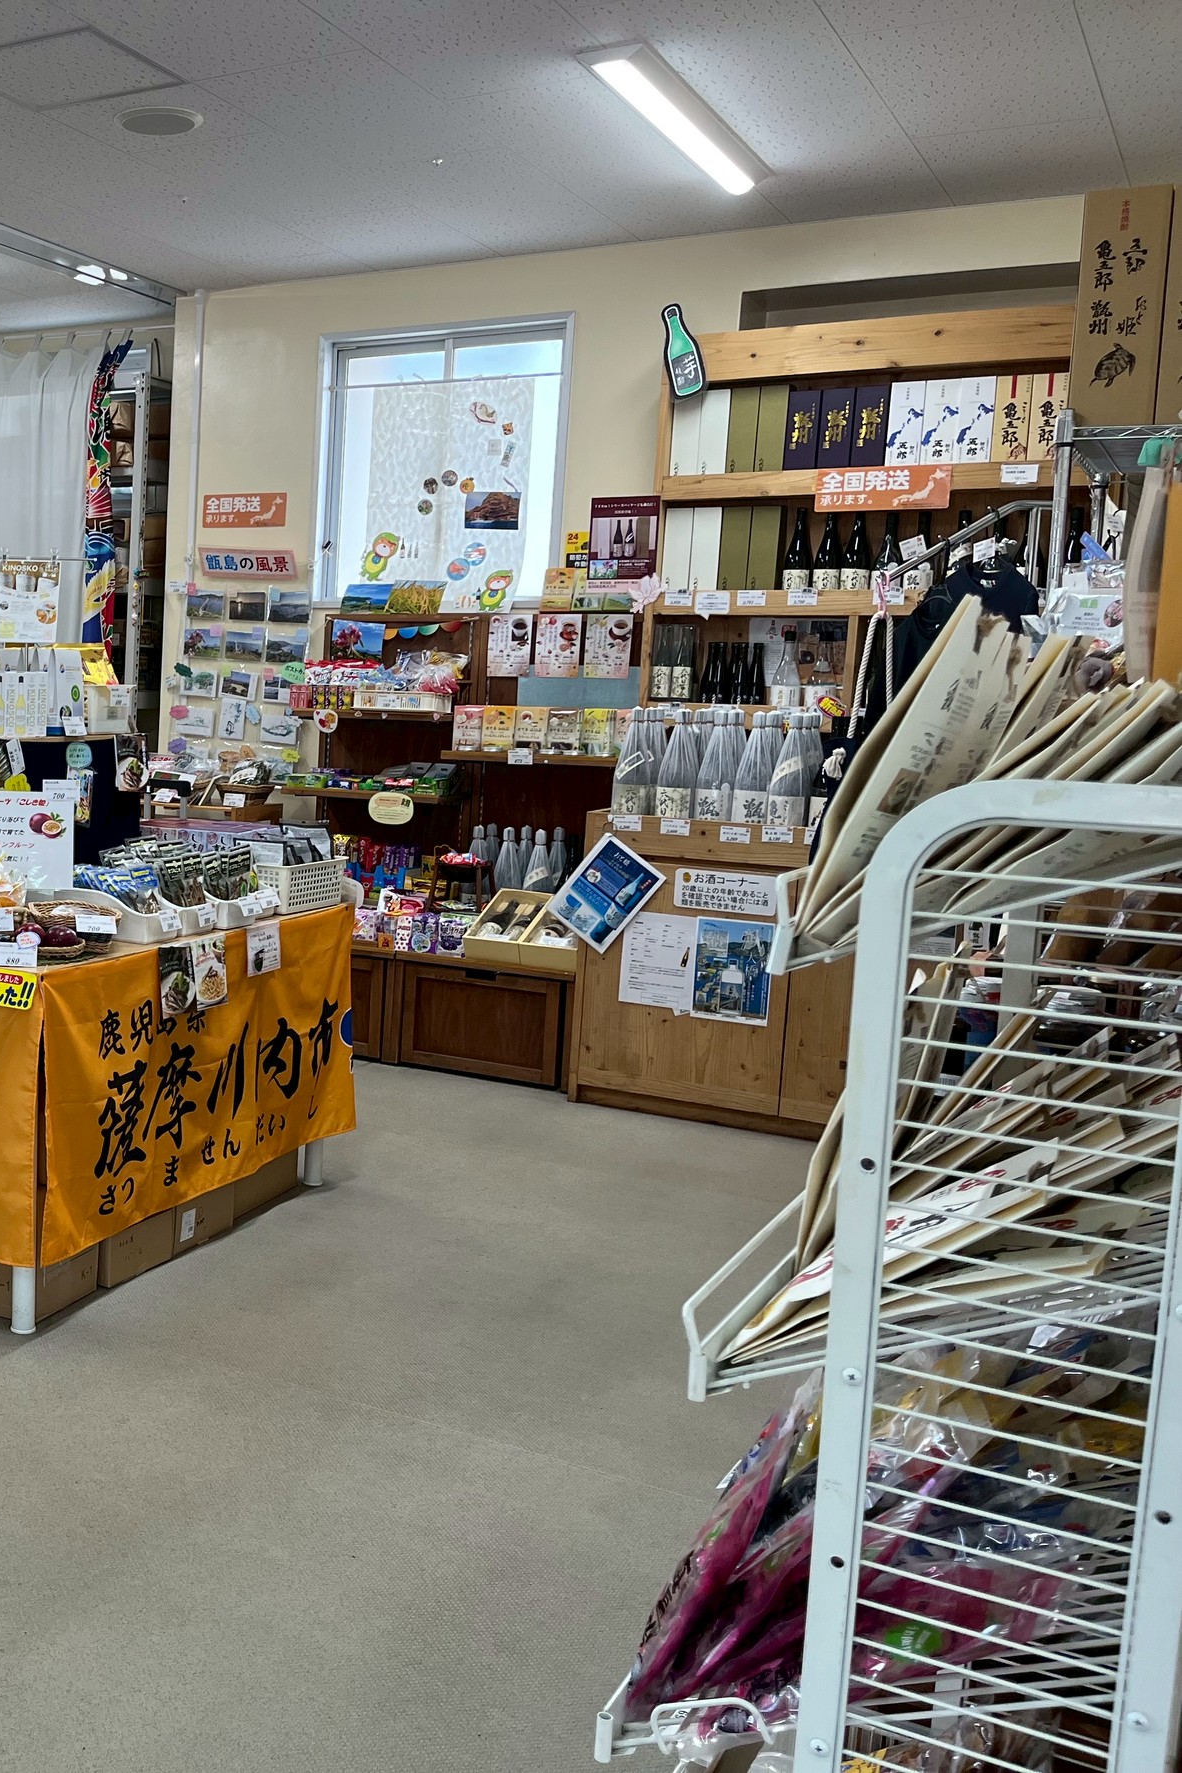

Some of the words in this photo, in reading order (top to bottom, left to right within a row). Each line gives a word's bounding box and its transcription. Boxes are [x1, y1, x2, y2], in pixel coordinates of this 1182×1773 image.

[1002, 402, 1021, 447] 亀五郎
[821, 469, 910, 492] 全国発送
[206, 496, 261, 514] 全国発送
[820, 493, 876, 506] 承ります。
[205, 514, 239, 523] 承ります。
[205, 554, 289, 573] 甑島の風景
[694, 873, 760, 887] お酒コーナー
[681, 885, 768, 899] 20歳以上の年齢であること
[681, 892, 768, 907] を確認できない場合には酒
[680, 900, 746, 912] 類を販売できません
[94, 997, 339, 1179] 薩摩川内市
